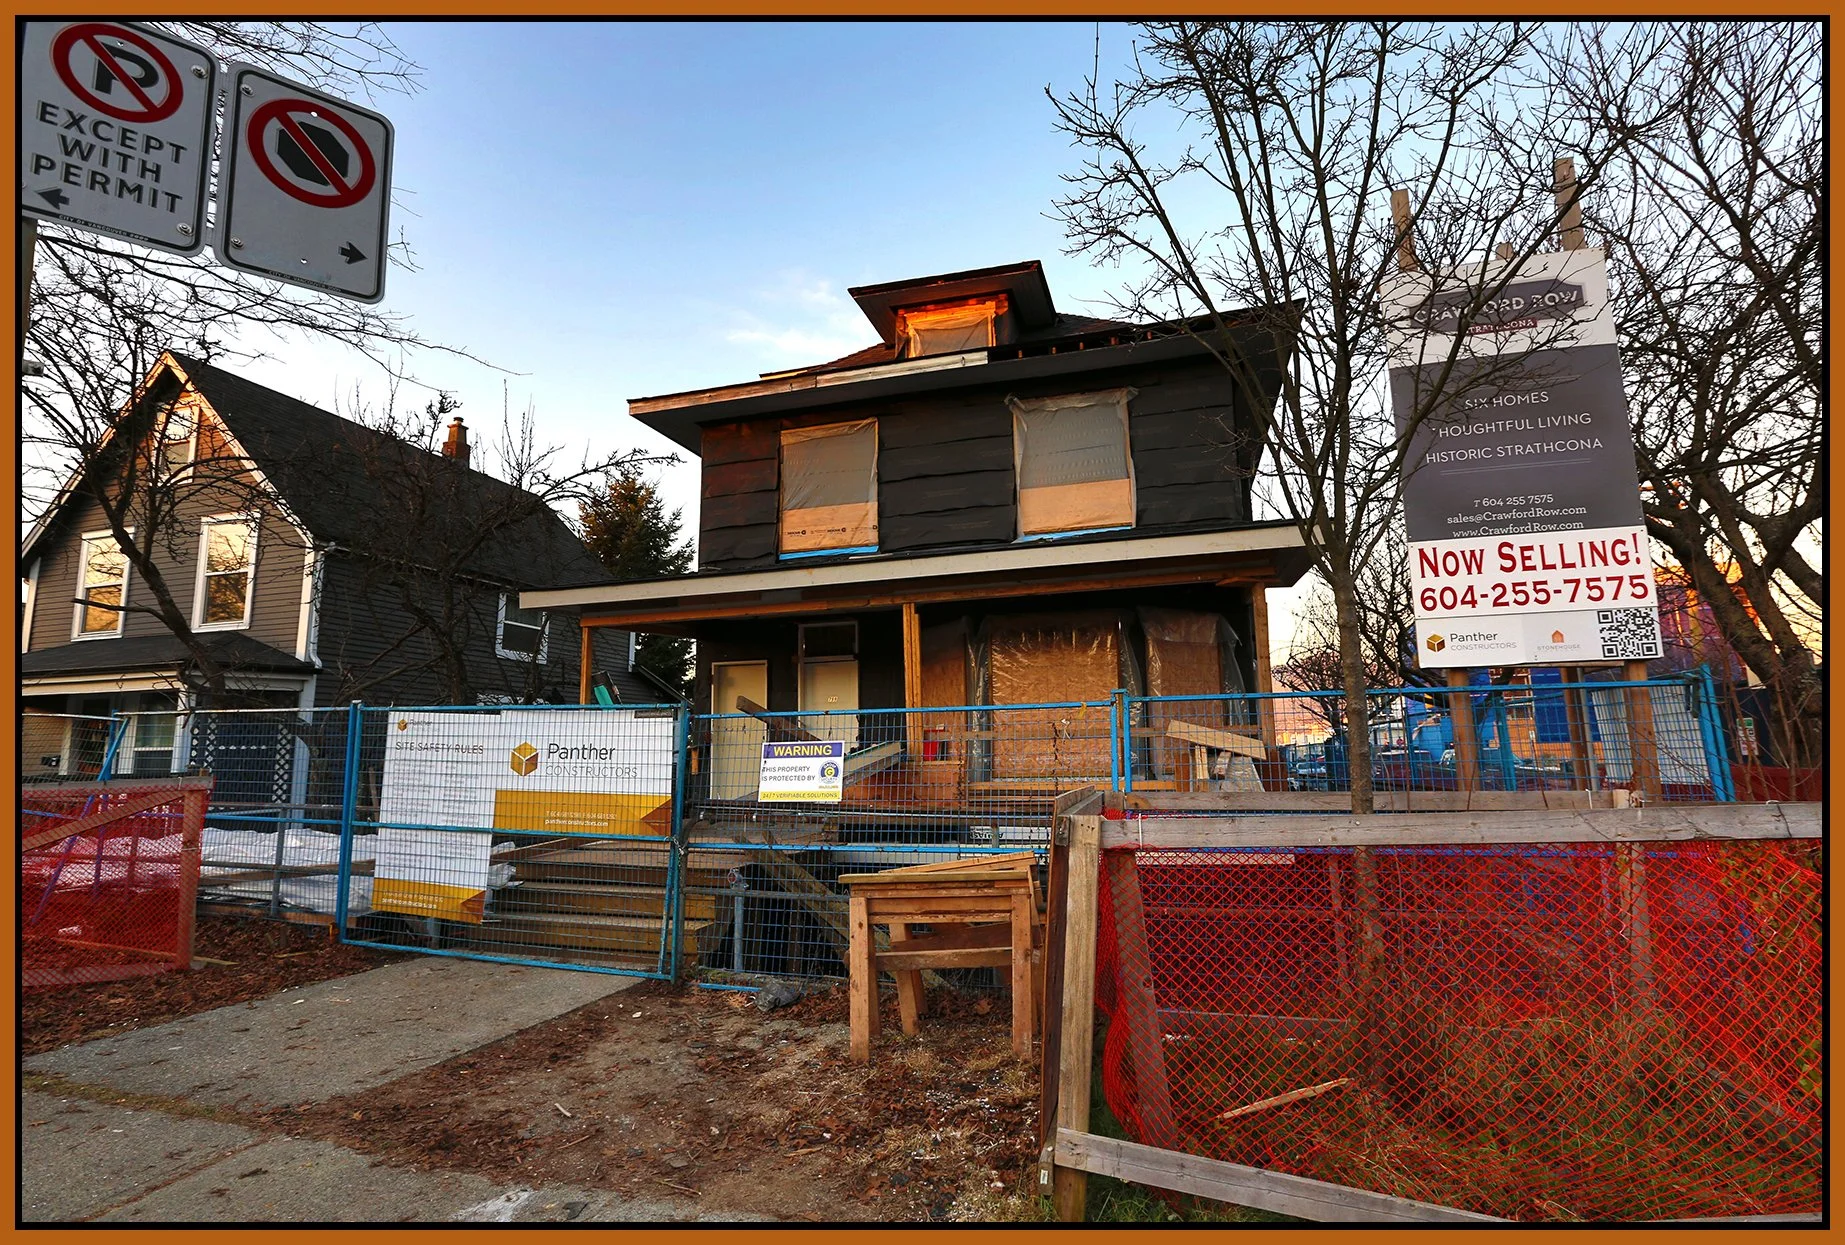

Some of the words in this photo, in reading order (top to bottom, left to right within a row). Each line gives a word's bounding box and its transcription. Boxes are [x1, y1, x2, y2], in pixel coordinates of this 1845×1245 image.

[37, 100, 187, 164] EXCEPT
[57, 133, 162, 183] WITH
[32, 153, 183, 214] PERMIT
[1465, 398, 1489, 410] SIX
[1492, 391, 1549, 408] HOMES
[1432, 419, 1534, 438] HOUGHTFUL
[1538, 412, 1592, 429] LIVING
[1425, 447, 1493, 463] HISTORIC
[1496, 438, 1603, 457] STRATHCONA
[1482, 497, 1504, 507] 604
[1506, 496, 1526, 505] 255
[1528, 494, 1554, 504] 7575
[1447, 506, 1587, 524] sales@CrawfordRow.com
[1453, 521, 1584, 538] www.CrawfordRow.com
[1420, 574, 1649, 612] 604-255-7575
[1450, 632, 1498, 643] Panther
[1450, 642, 1517, 652] CONSTRUCTORS
[396, 741, 415, 751] SITE
[418, 742, 452, 753] SAFETY
[454, 743, 484, 754] RULES
[547, 743, 616, 761] Panther
[773, 745, 832, 757] WARNING
[545, 765, 638, 778] CONSTRUCTORS
